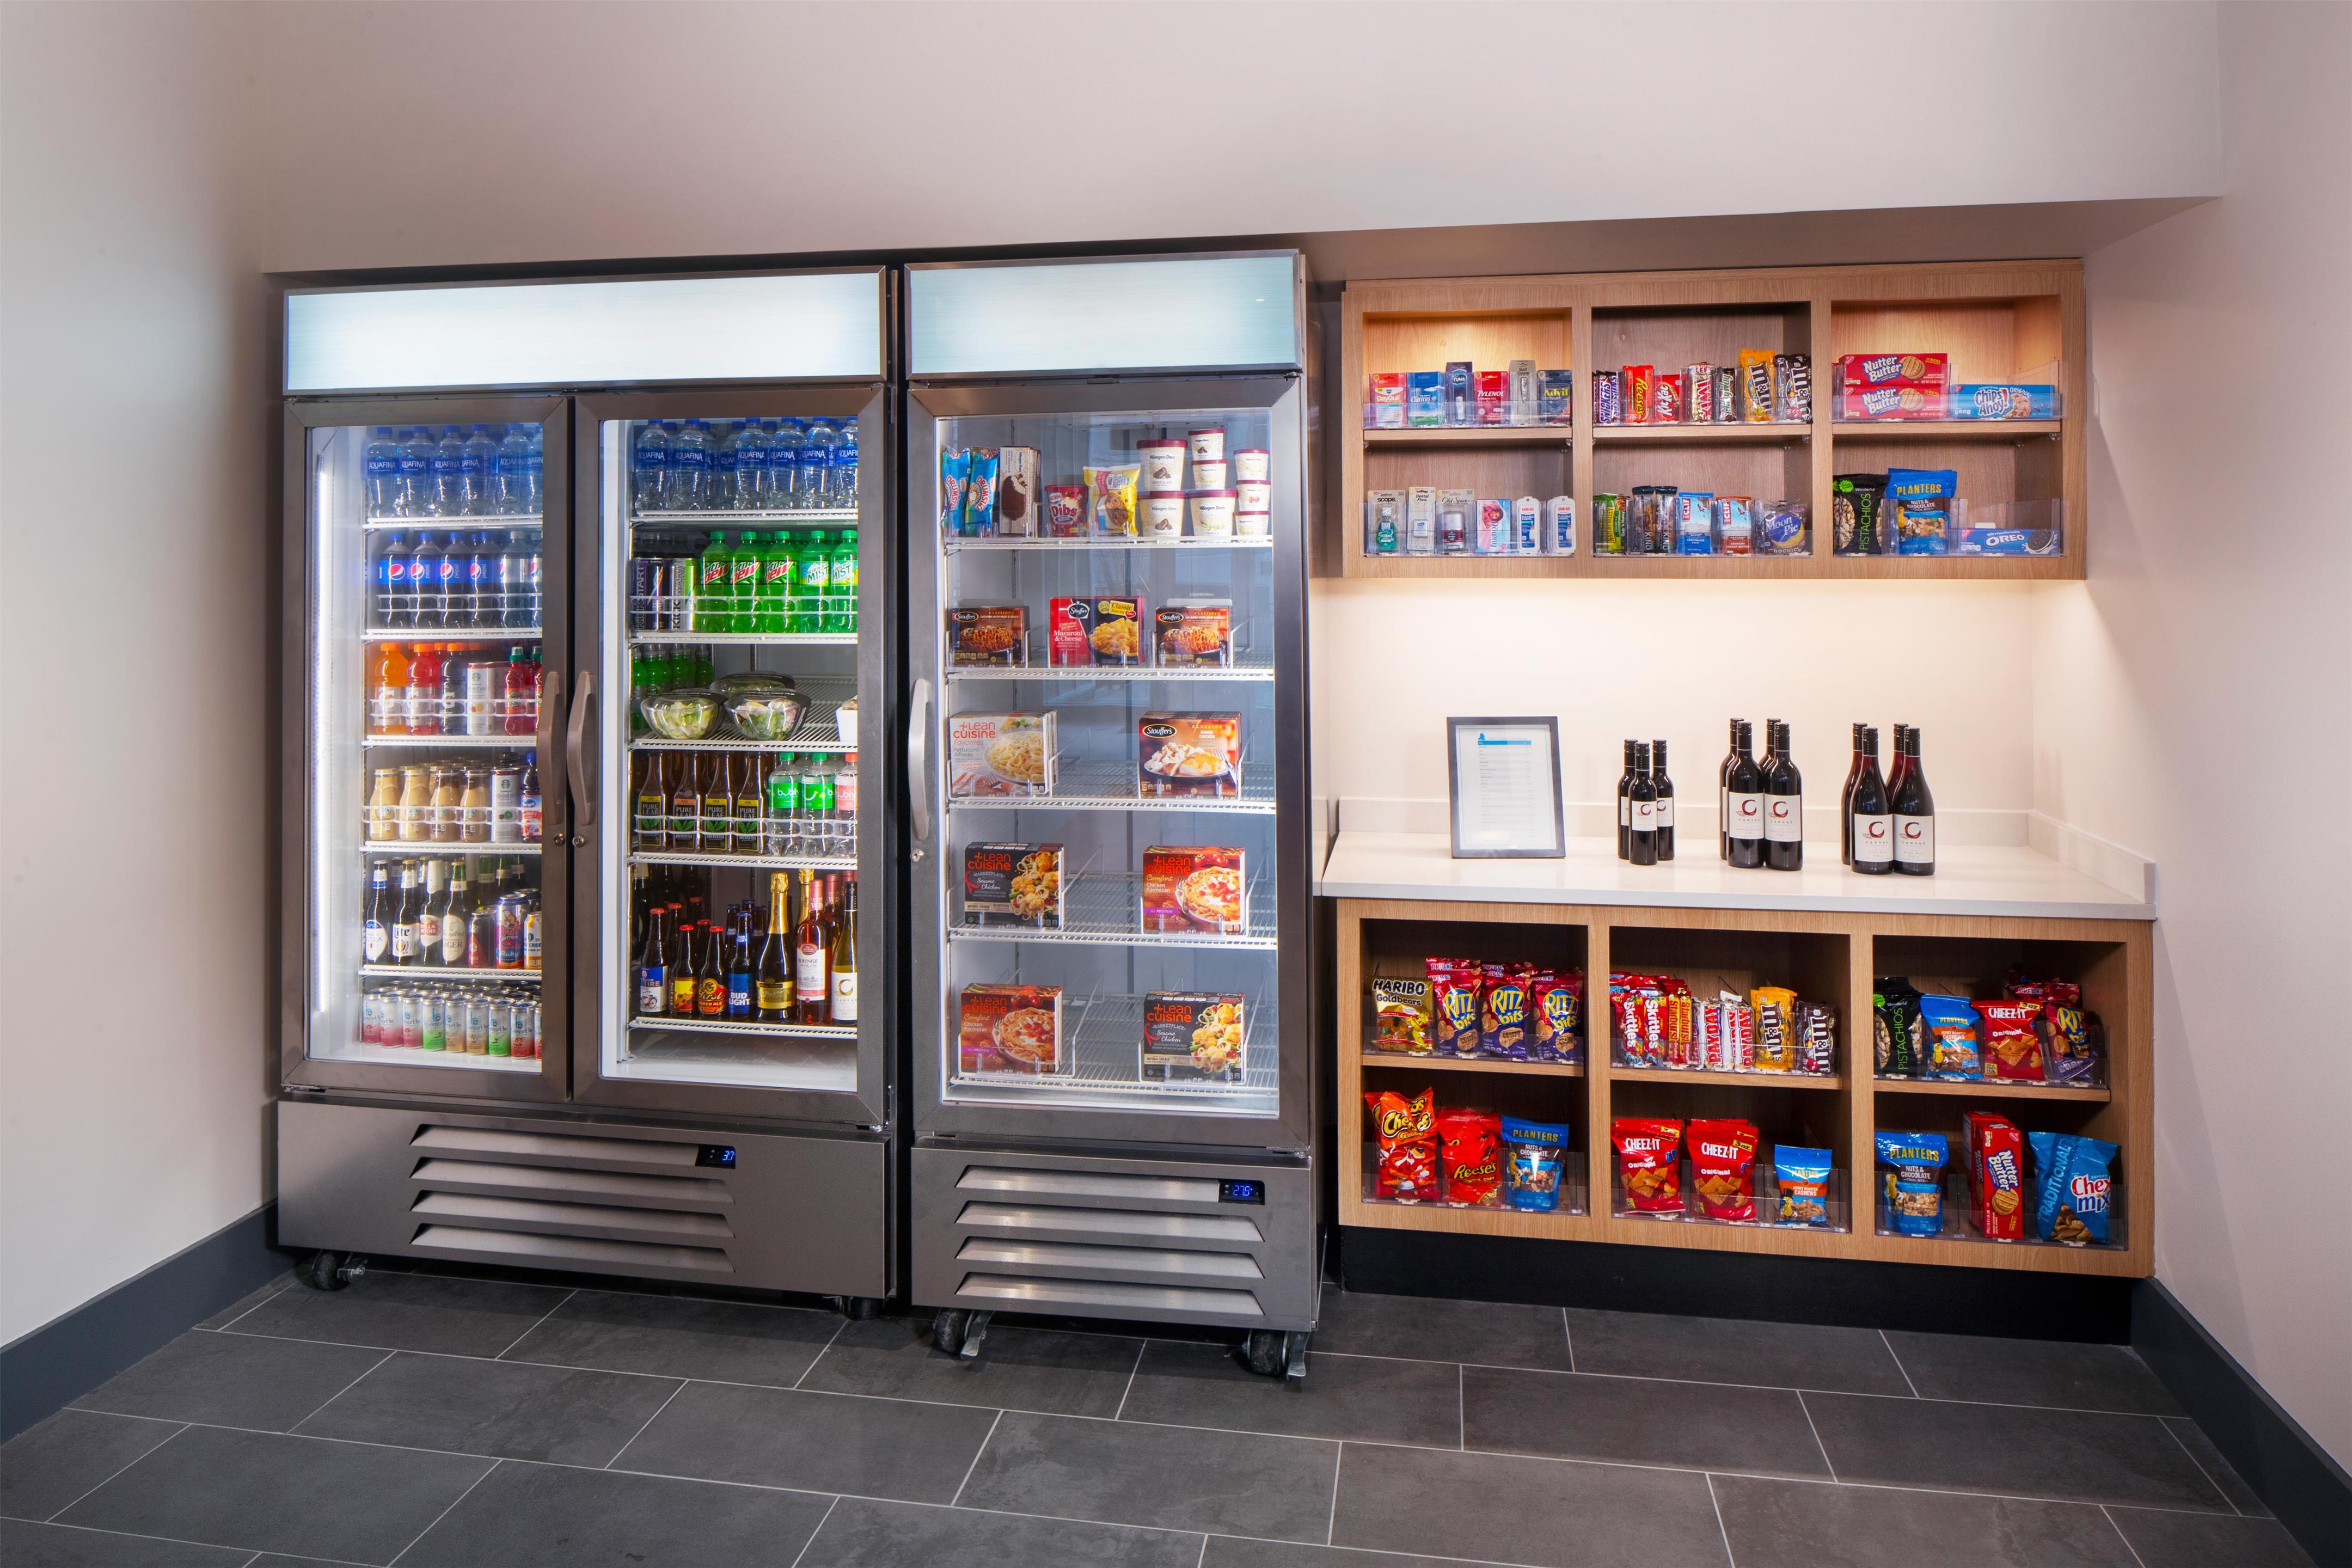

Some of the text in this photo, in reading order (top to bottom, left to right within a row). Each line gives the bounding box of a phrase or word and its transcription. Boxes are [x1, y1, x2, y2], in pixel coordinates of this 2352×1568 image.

[1863, 357, 1897, 373] Nutter
[1869, 364, 1902, 382] Butter
[1543, 388, 1569, 396] Advil
[1636, 377, 1649, 415] Reese's
[1862, 389, 1896, 405] Nutter
[1975, 389, 2002, 406] Chips
[2010, 387, 2032, 399] ORIGINAL
[1867, 395, 1901, 414] Butter
[638, 451, 665, 461] AQUAFINA
[675, 452, 704, 461] AQUAFINA
[738, 451, 764, 460] AQUAFINA
[770, 451, 795, 460] AQUAFINA
[369, 461, 396, 469] AQUAFINA
[1896, 484, 1941, 497] PLANTERS
[1051, 503, 1077, 517] Dibs
[1765, 517, 1792, 533] Moon
[1859, 493, 1871, 550] PISTACHIOS
[1784, 523, 1799, 536] Pie
[1986, 534, 2025, 547] OREO
[1112, 602, 1133, 610] Classic
[969, 722, 995, 730] Lean
[1147, 727, 1173, 736] Stouffer's
[1163, 856, 1191, 866] Lean
[1146, 874, 1173, 882] Comfort
[394, 926, 409, 939] Lite
[1373, 979, 1425, 996] HARIBO
[980, 997, 1007, 1005] Lean
[1376, 994, 1422, 1006] Goldbears
[1444, 993, 1474, 1019] RITZ
[1491, 989, 1524, 1014] RITZ
[1544, 994, 1577, 1018] RITZ
[1163, 1004, 1192, 1013] Lean
[1498, 1010, 1523, 1025] bits
[1552, 1016, 1577, 1031] bits
[1623, 1001, 1639, 1048] Skittles
[1645, 1000, 1661, 1049] Skittles
[1704, 1007, 1722, 1065] PAYDAY
[1737, 1008, 1753, 1068] PAYDAY
[1893, 1008, 1908, 1070] PISTACHIOS
[1513, 1129, 1558, 1142] PLANTERS
[722, 1150, 734, 1160] 37
[1890, 1147, 1939, 1161] PLANTERS
[1454, 1162, 1496, 1179] Reese's
[1988, 1155, 2010, 1191] Butter
[1999, 1149, 2018, 1186] Nutter
[1901, 1171, 1931, 1179] CHOCOLATE
[2038, 1145, 2072, 1222] TRADITIONAL
